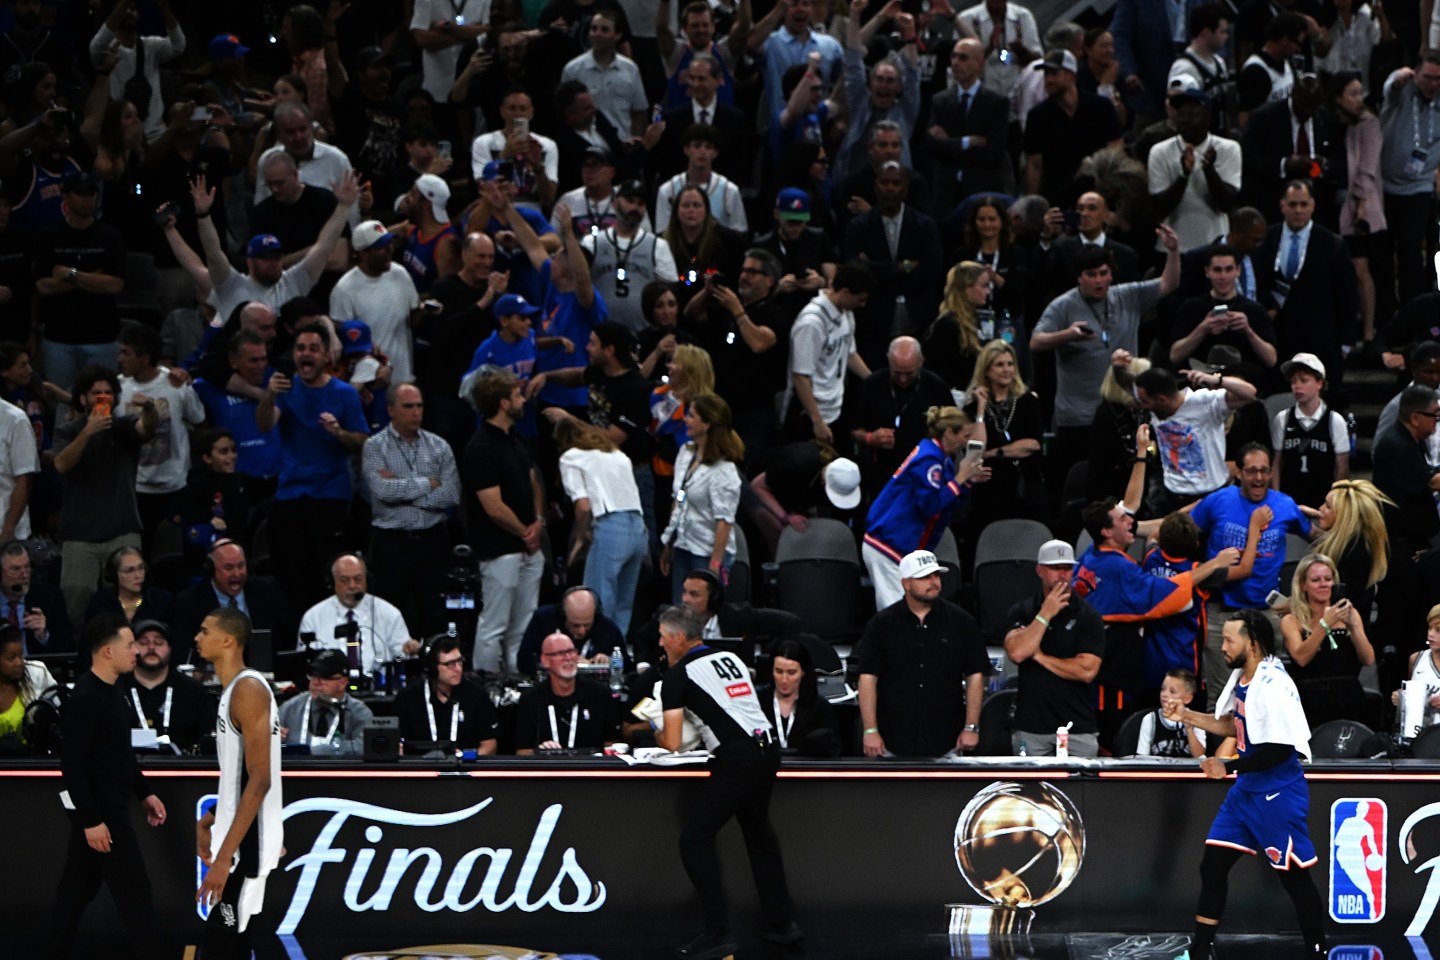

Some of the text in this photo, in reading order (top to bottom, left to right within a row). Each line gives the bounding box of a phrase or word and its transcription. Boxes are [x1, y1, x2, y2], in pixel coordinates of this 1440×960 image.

[1299, 455, 1309, 473] 1
[710, 656, 743, 681] 48
[276, 797, 607, 935] Finals
[1337, 894, 1365, 915] NBA
